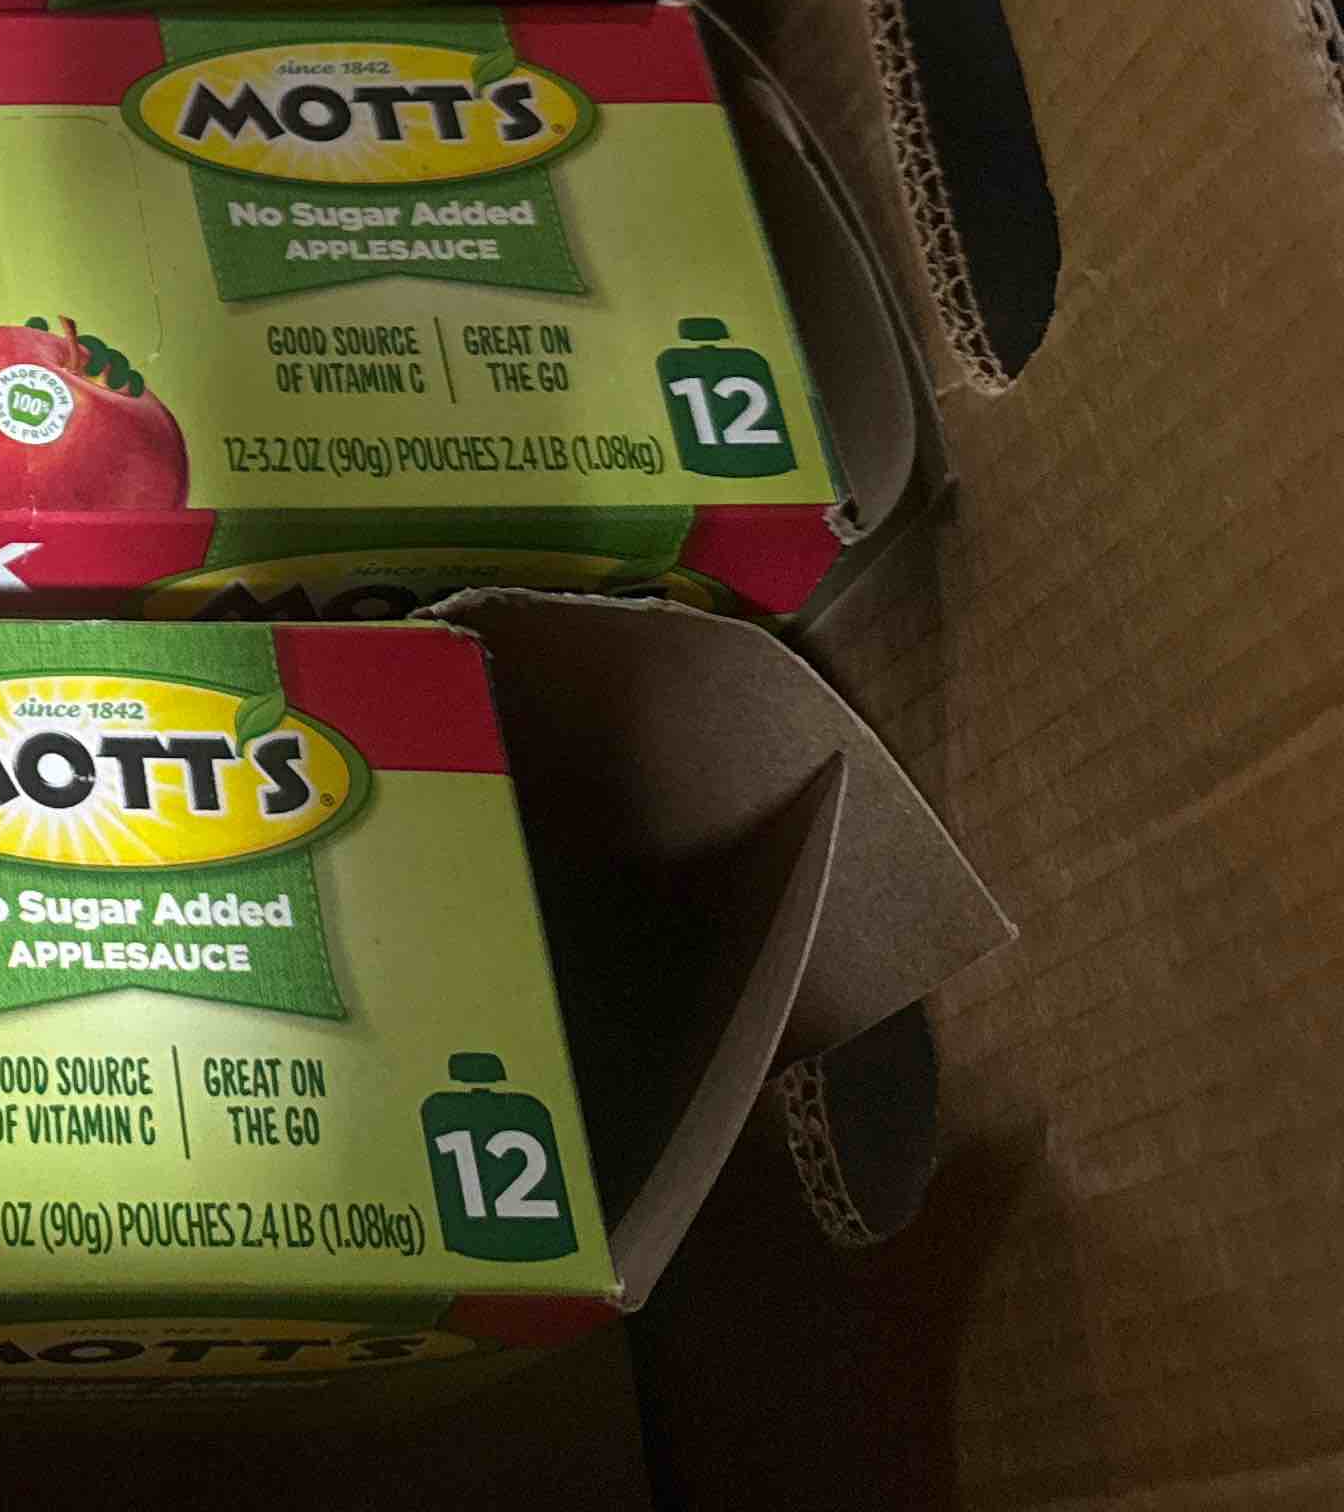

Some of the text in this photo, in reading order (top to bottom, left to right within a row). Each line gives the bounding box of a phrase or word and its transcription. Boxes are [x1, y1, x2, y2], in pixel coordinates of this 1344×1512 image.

[278, 59, 391, 77] since 1842
[178, 82, 543, 144] MOTT'S
[229, 199, 536, 232] No Sugar Added
[285, 239, 501, 262] APPLESAUCE
[267, 324, 422, 357] GOOD SOURCE
[462, 324, 572, 356] GREAT ON
[276, 362, 426, 396] OF VITAMIN C
[486, 363, 569, 393] THE GO
[670, 378, 782, 445] 12
[328, 435, 392, 478] (90g)
[396, 436, 500, 472] POUCHES
[541, 435, 569, 471] LB
[573, 434, 664, 476] (1.08kg)
[14, 697, 144, 720] since 1842
[18, 890, 143, 930] Sugar
[153, 892, 293, 928] Added
[7, 941, 251, 972] APPLESAUCE
[56, 1056, 154, 1098] SOURCE
[204, 1056, 326, 1099] GREAT ON
[25, 1104, 135, 1145] VITAMIN
[138, 1105, 157, 1145] C
[226, 1106, 320, 1145] THE GO
[435, 1129, 560, 1220] 12
[1, 1201, 32, 1247] OZ
[40, 1200, 113, 1256] (90g)
[118, 1201, 233, 1248] POUCHES
[241, 1201, 280, 1247] 2.4
[285, 1201, 315, 1247] LB
[321, 1201, 427, 1257] (1.08kg)
